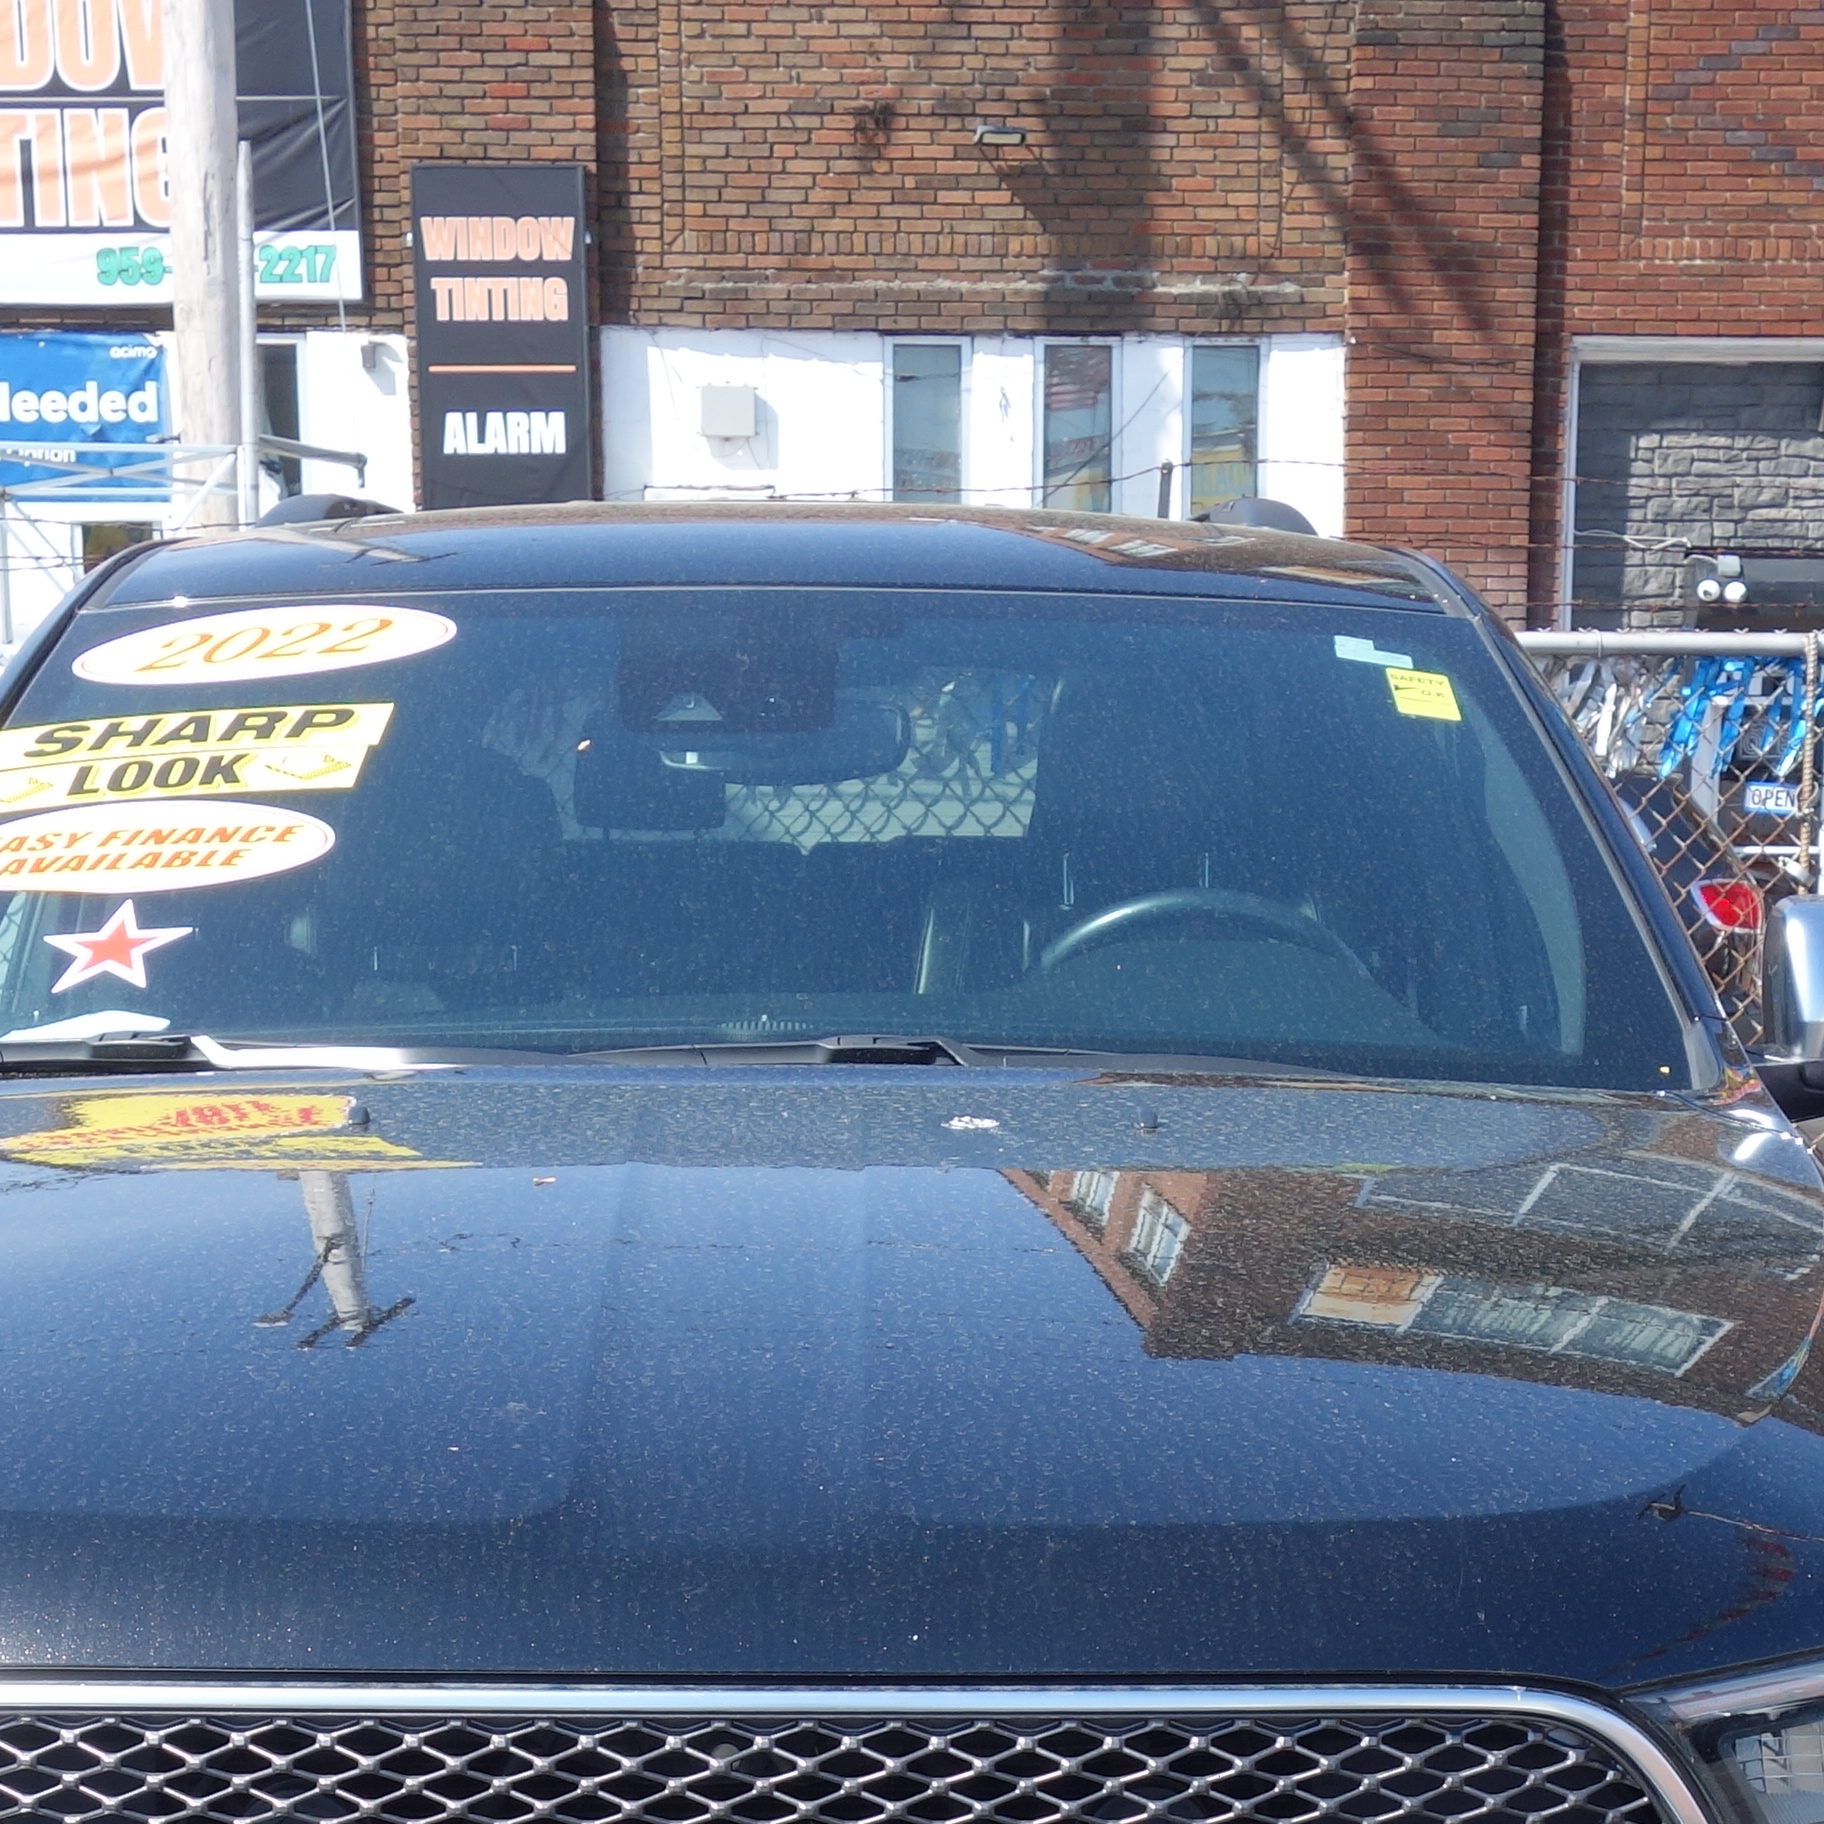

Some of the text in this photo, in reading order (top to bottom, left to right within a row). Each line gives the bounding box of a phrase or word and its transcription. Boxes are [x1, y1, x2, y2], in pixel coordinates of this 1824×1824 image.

[420, 216, 575, 261] WINDOW
[430, 277, 569, 322] TINTING
[443, 411, 567, 455] ALARM
[135, 617, 394, 674] 2022
[1389, 673, 1446, 687] SAFETY
[23, 706, 358, 758] SHARP
[66, 752, 251, 797] LOOK
[1752, 789, 1795, 807] OPEN
[101, 822, 305, 849] FINANCE
